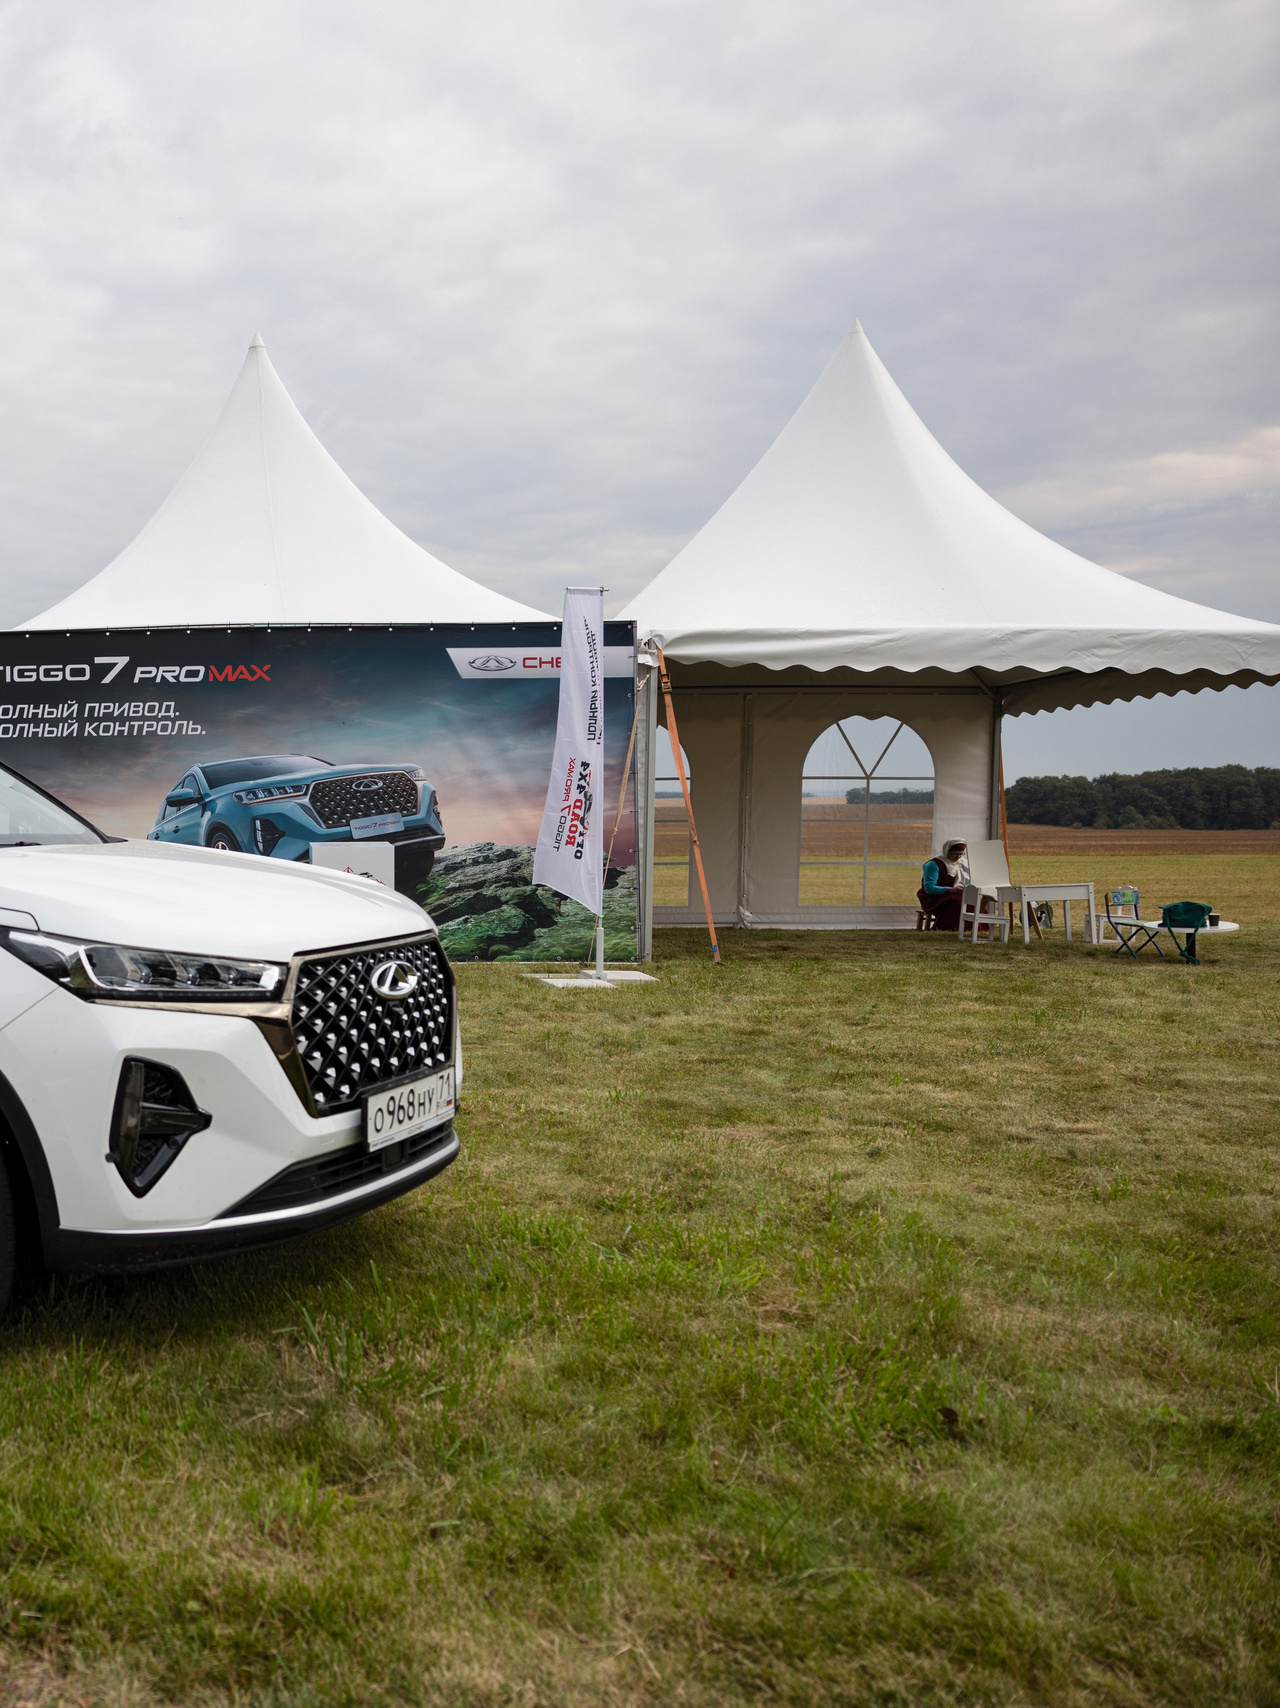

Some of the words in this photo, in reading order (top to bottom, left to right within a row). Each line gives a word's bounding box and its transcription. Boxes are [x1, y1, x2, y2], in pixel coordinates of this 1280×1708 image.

[94, 656, 130, 684] 7
[522, 656, 561, 669] CHE
[84, 701, 180, 719] ПРИВОД.
[84, 720, 207, 737] КОНТРОЛЬ.
